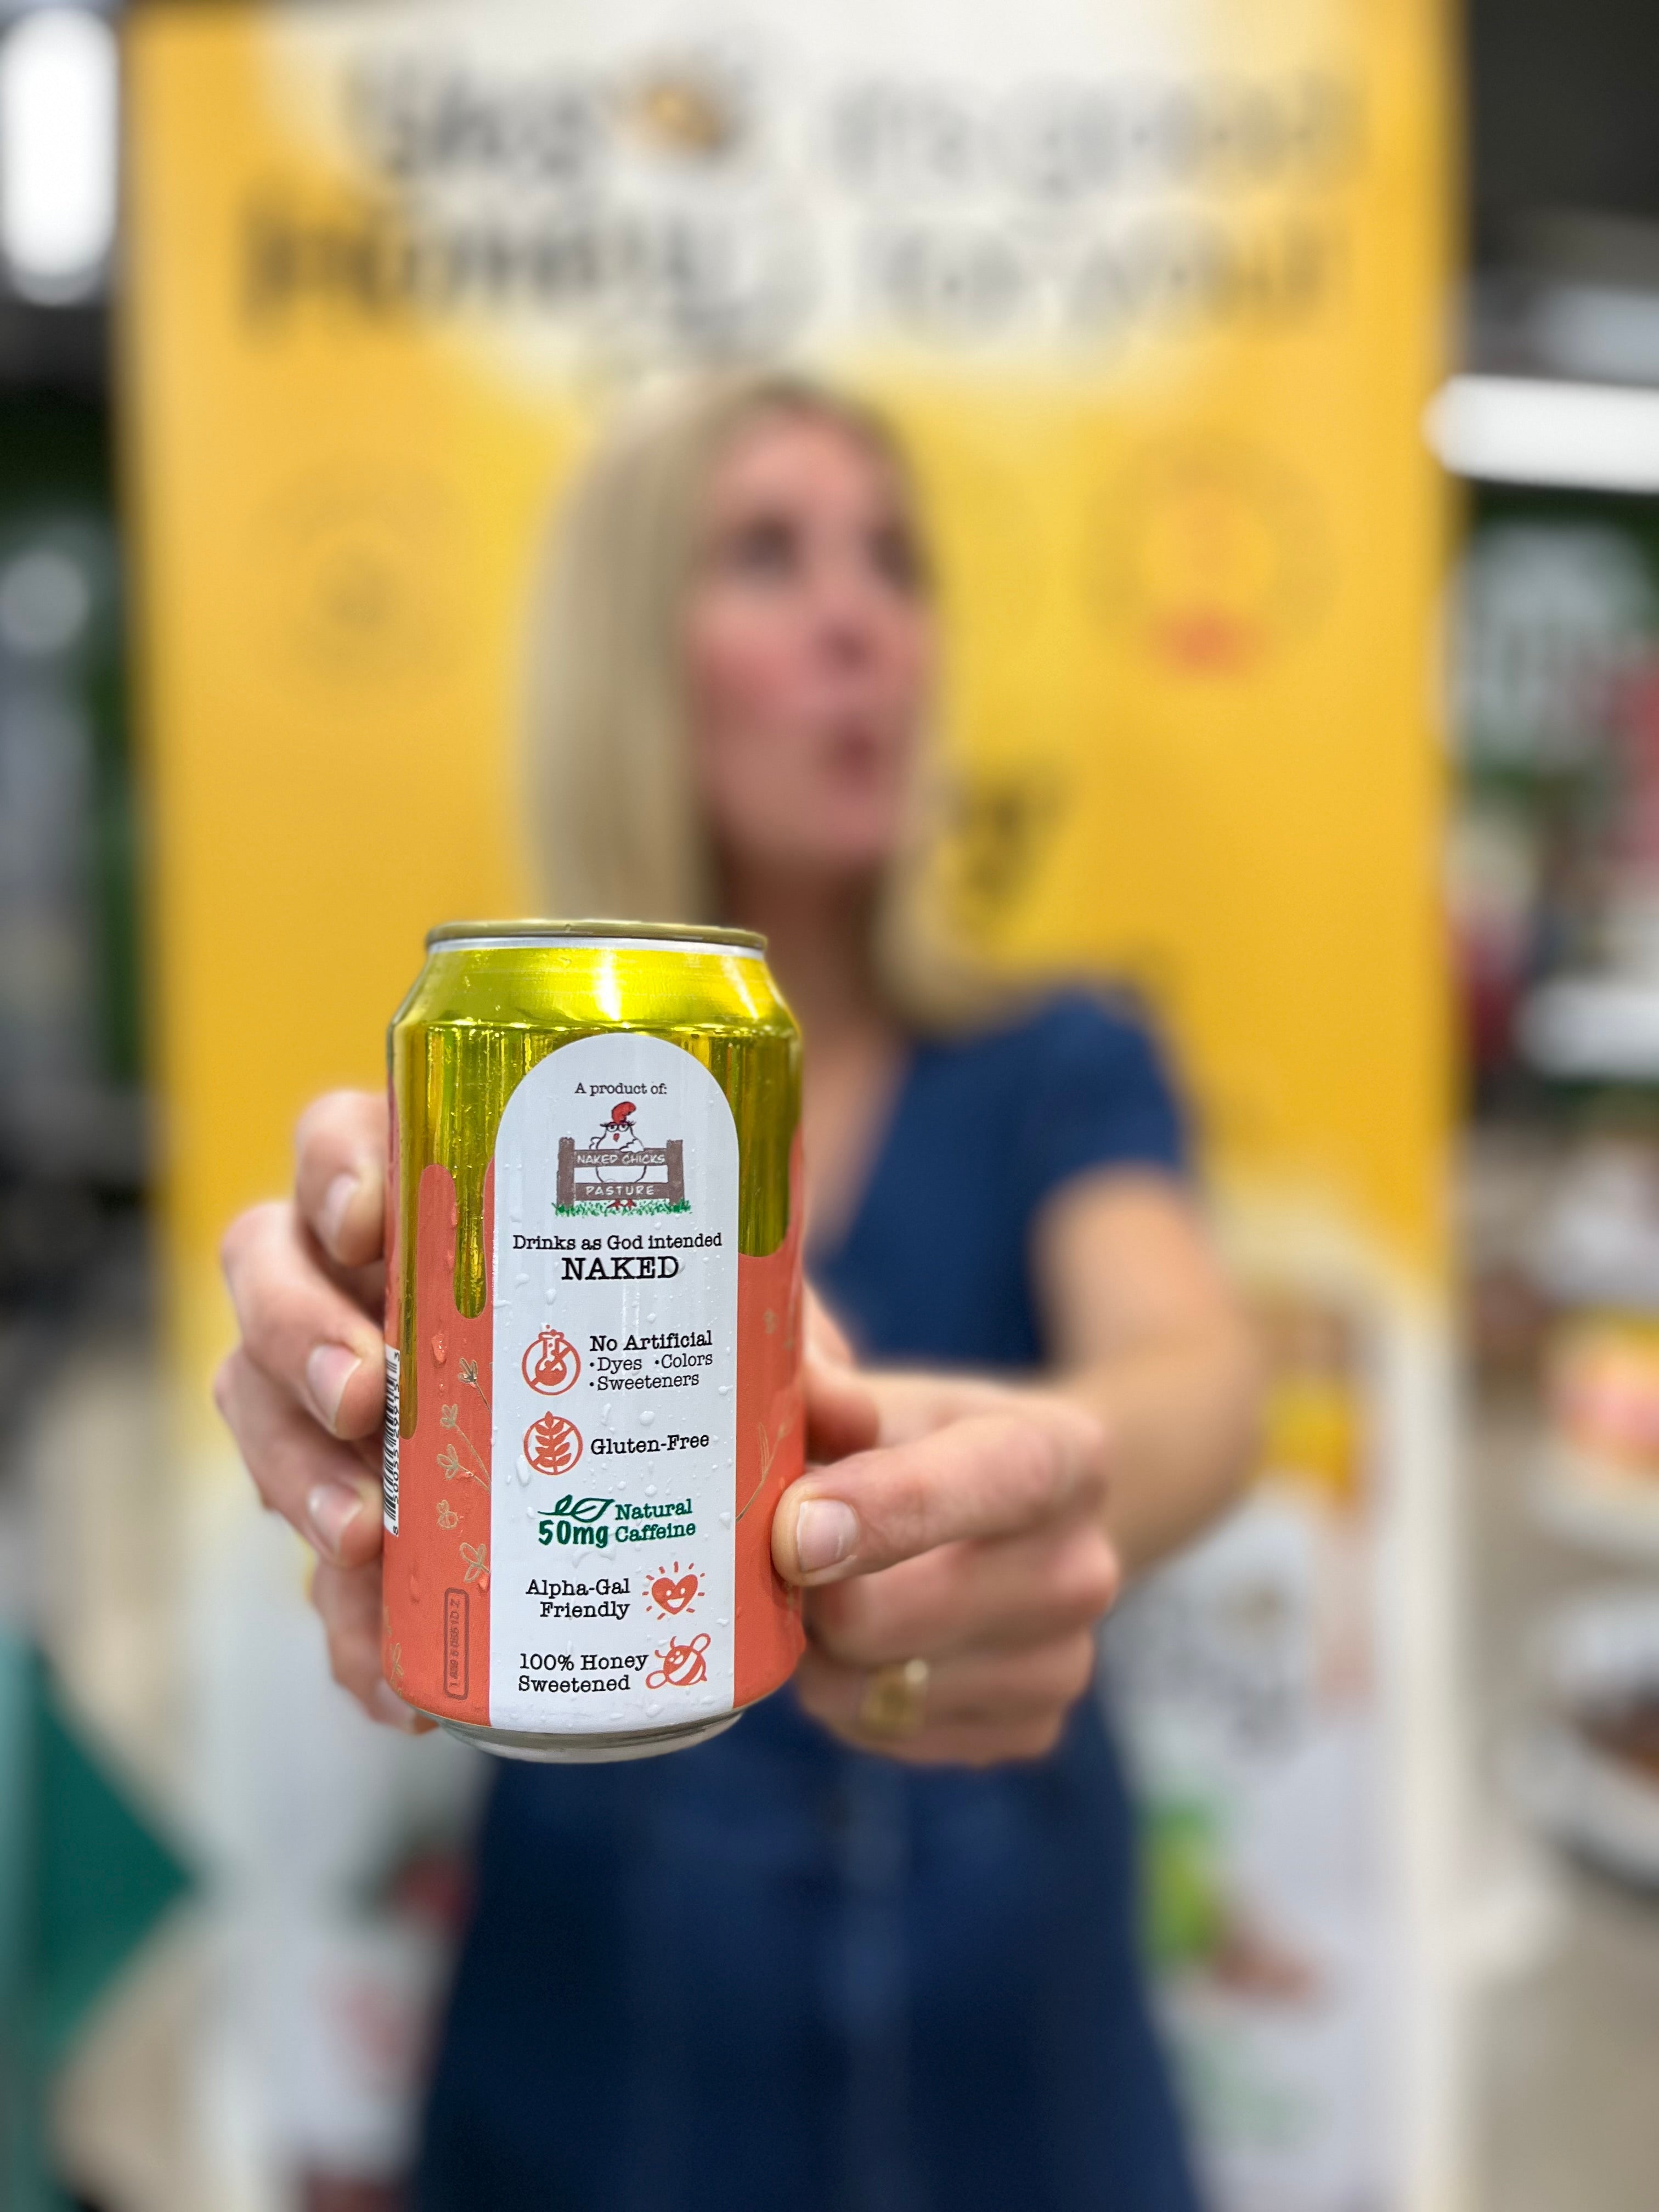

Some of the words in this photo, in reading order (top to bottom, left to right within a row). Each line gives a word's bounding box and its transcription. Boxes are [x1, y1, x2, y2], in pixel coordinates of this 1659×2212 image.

[575, 1083, 586, 1093] A
[590, 1083, 647, 1096] product
[651, 1084, 668, 1094] of:
[577, 1154, 618, 1164] NAKED
[622, 1154, 665, 1164] CHICKS
[586, 1185, 654, 1195] PASTURE
[513, 1235, 575, 1250] Drinks
[582, 1239, 601, 1250] as
[607, 1235, 643, 1250] God
[648, 1233, 722, 1249] intended
[562, 1256, 679, 1280] NAKED
[590, 1335, 617, 1351] No
[623, 1330, 712, 1350] Artificial
[591, 1435, 709, 1454] Gluten-Free
[615, 1499, 692, 1520] Natural
[539, 1520, 608, 1548] 50mg
[615, 1523, 696, 1542] Caffeine
[526, 1578, 630, 1599] Alpha-Gal
[540, 1601, 630, 1620] Friendly
[520, 1654, 574, 1671] 100%
[580, 1655, 648, 1671] Honey
[519, 1675, 630, 1692] Sweetened
